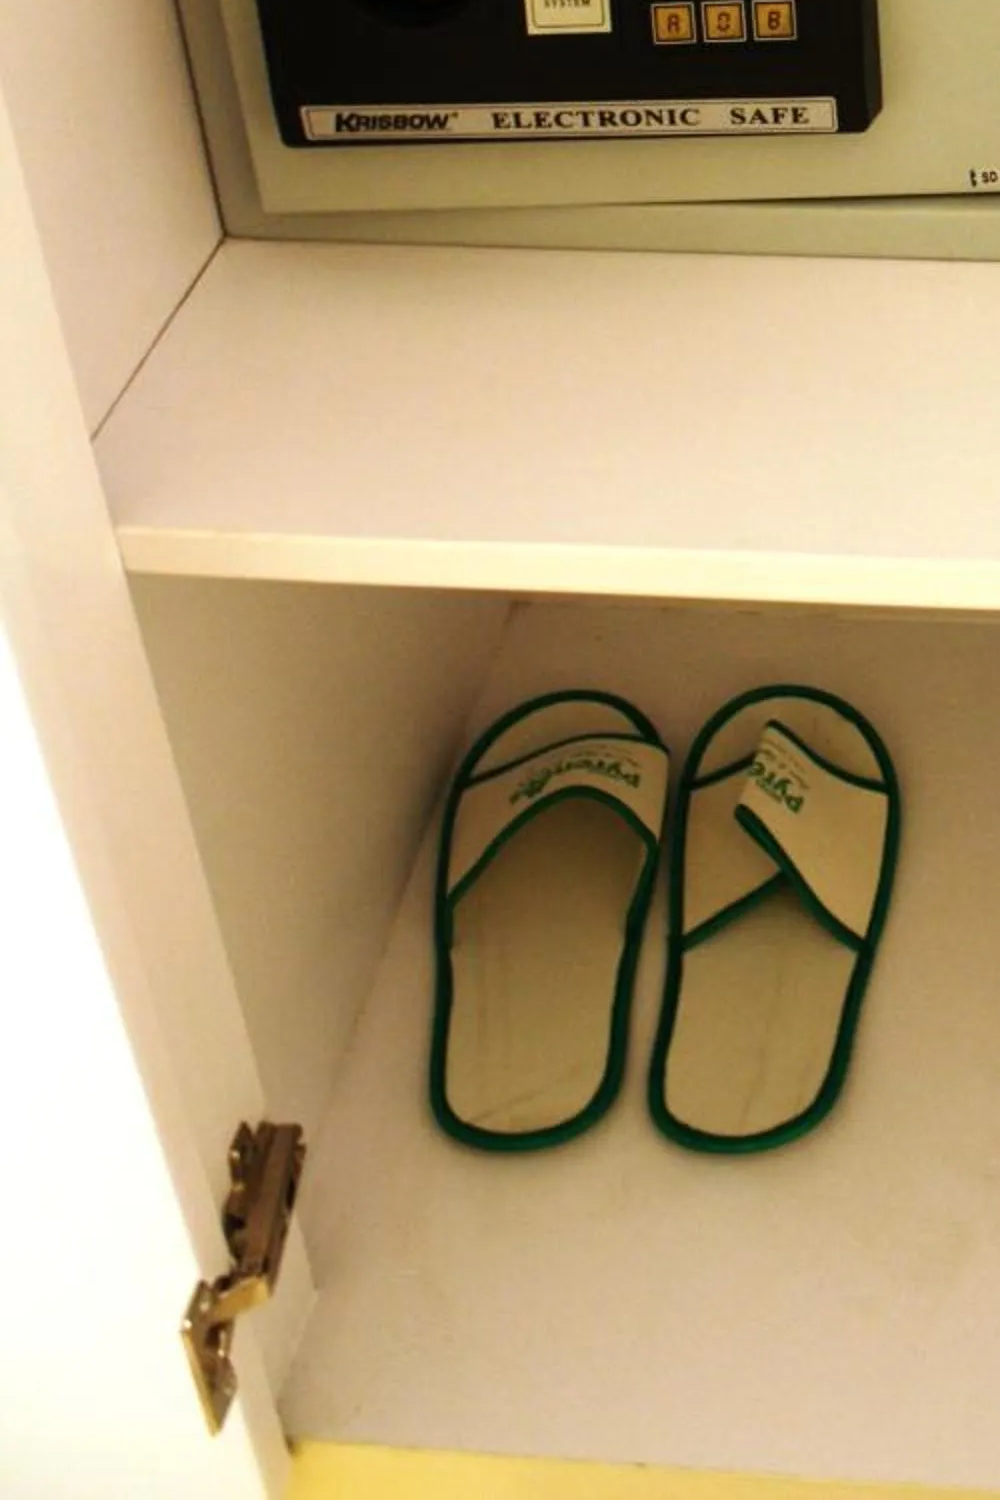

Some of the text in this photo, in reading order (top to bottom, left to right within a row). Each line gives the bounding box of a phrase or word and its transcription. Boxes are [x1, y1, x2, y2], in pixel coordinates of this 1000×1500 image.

[667, 12, 680, 34] A
[492, 107, 700, 130] ELECTRONIC
[729, 106, 810, 126] SAFE
[981, 171, 998, 183] SD
